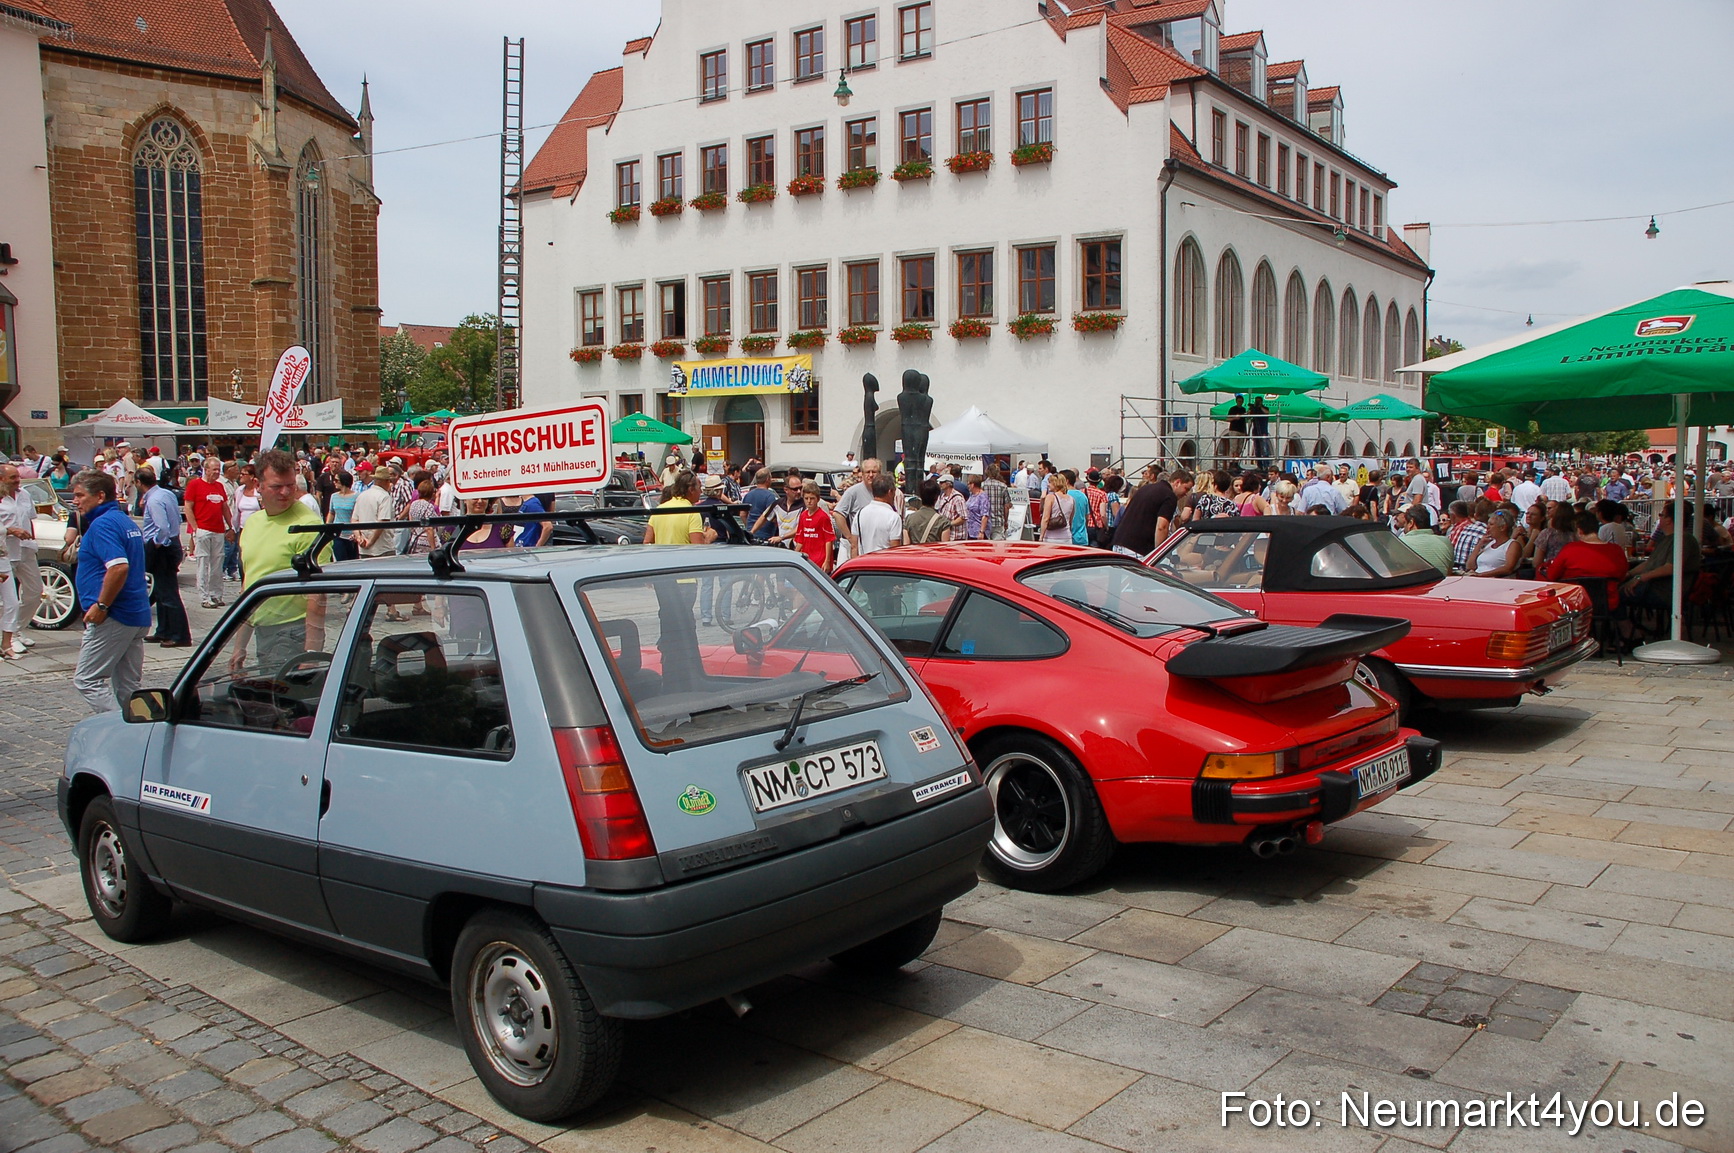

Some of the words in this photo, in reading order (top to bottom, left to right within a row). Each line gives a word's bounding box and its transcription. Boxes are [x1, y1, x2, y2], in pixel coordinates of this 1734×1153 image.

[1589, 337, 1728, 353] Neumarkter
[291, 360, 308, 387] IMBISS
[690, 363, 783, 389] ANMELDUNG
[460, 419, 595, 460] FAHRSCHULE
[462, 471, 471, 480] M.
[473, 467, 511, 480] Schreiner
[520, 463, 541, 475] 8431
[543, 460, 597, 472] Mühlhausen
[750, 766, 796, 806] NM
[804, 756, 836, 790] CP
[840, 745, 881, 780] 573
[1358, 767, 1374, 793] NM
[1376, 760, 1389, 785] KB
[1389, 753, 1405, 779] 911
[143, 784, 158, 795] AIR
[159, 787, 192, 803] FRANCE
[915, 788, 929, 797] AIR
[929, 777, 957, 792] FRANCE
